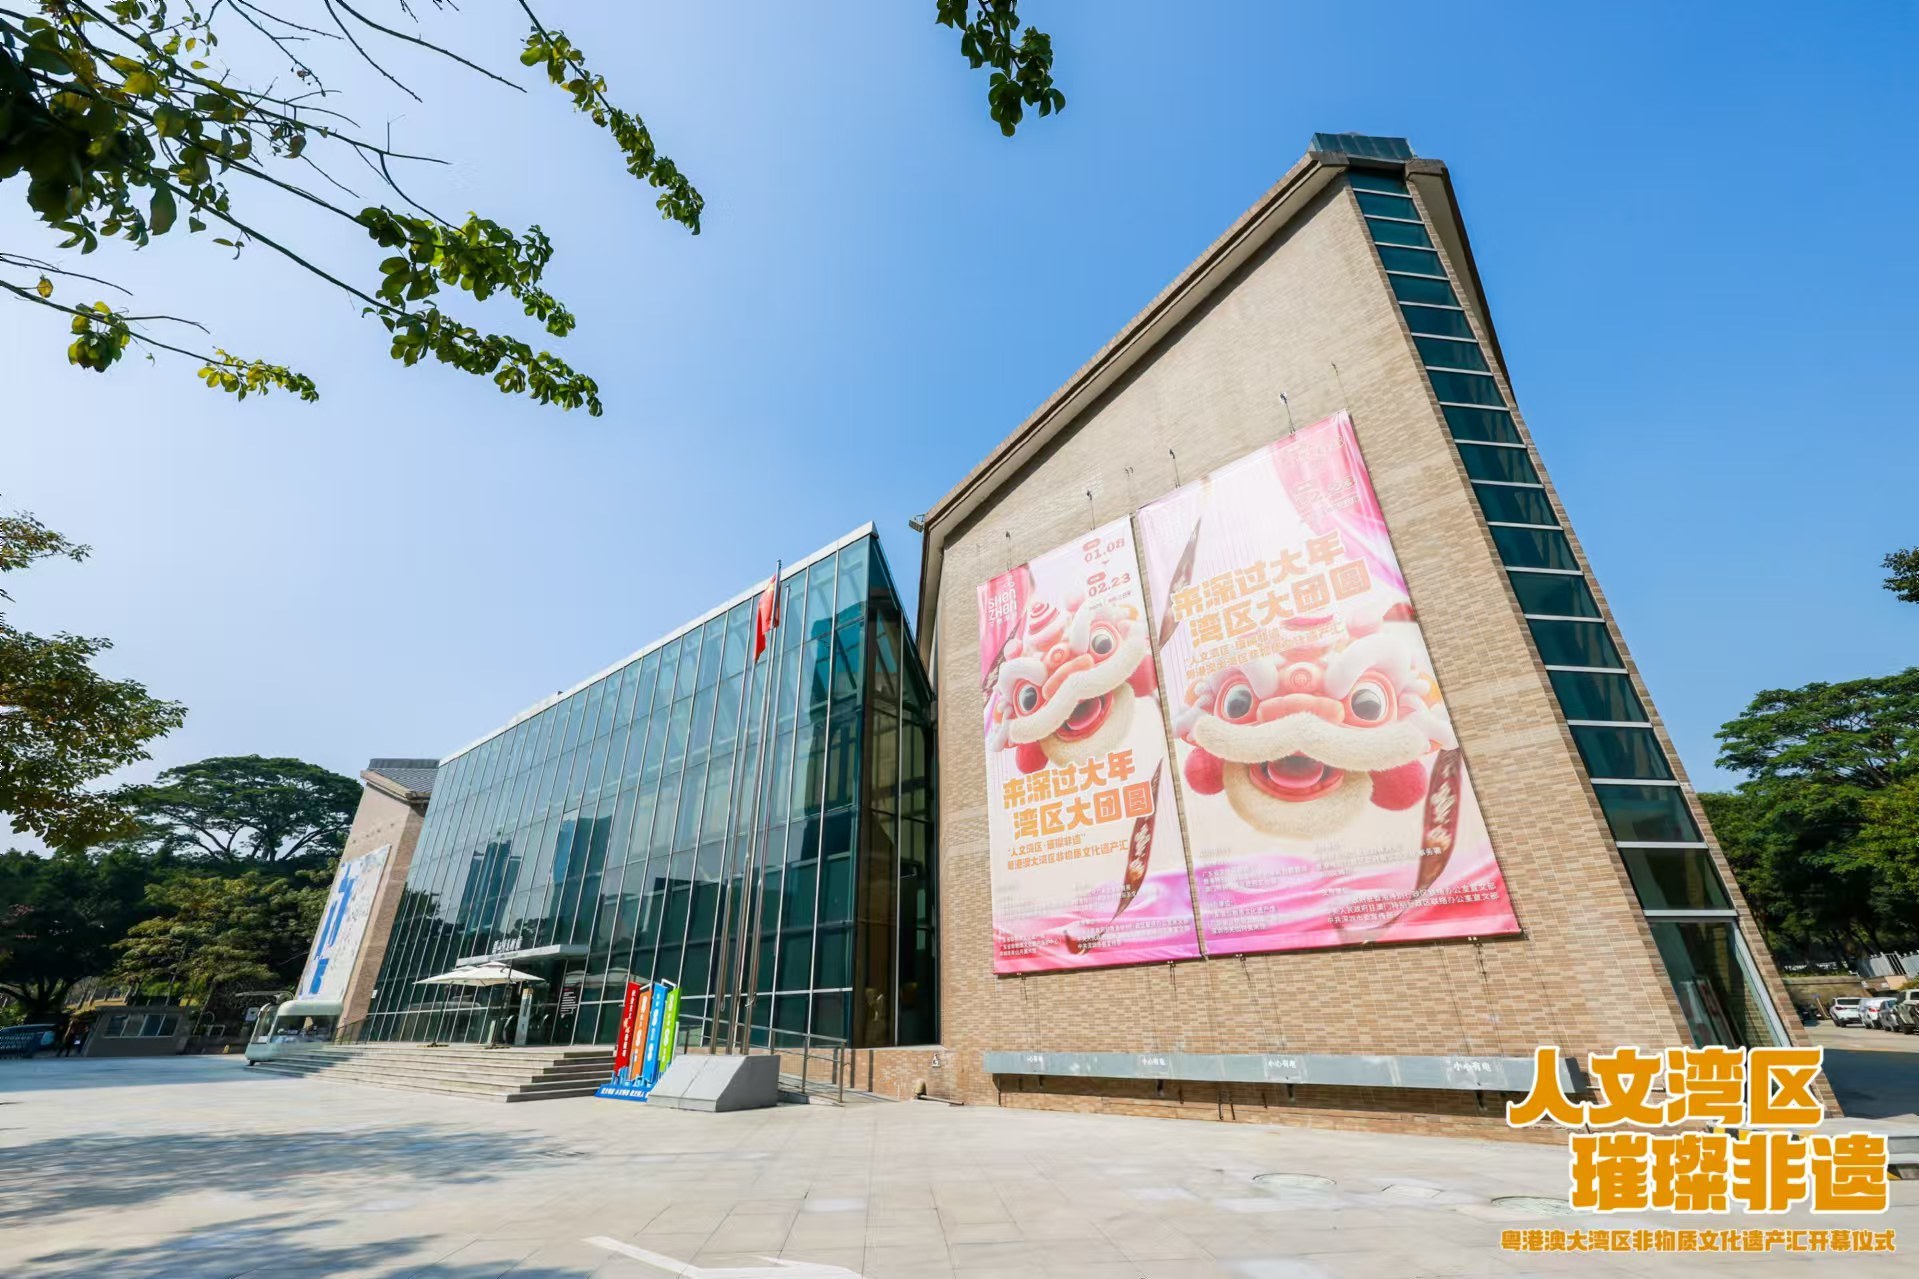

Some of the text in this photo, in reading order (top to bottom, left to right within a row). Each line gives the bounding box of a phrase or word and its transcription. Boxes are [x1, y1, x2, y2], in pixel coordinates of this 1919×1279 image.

[1084, 538, 1125, 562] 01.08
[1173, 529, 1346, 622] 来深过大年
[1088, 572, 1131, 597] 02.23
[1189, 558, 1373, 648] 湾区大团圆
[1002, 749, 1135, 809] 来深过大年
[1013, 781, 1154, 840] 湾区大团圆
